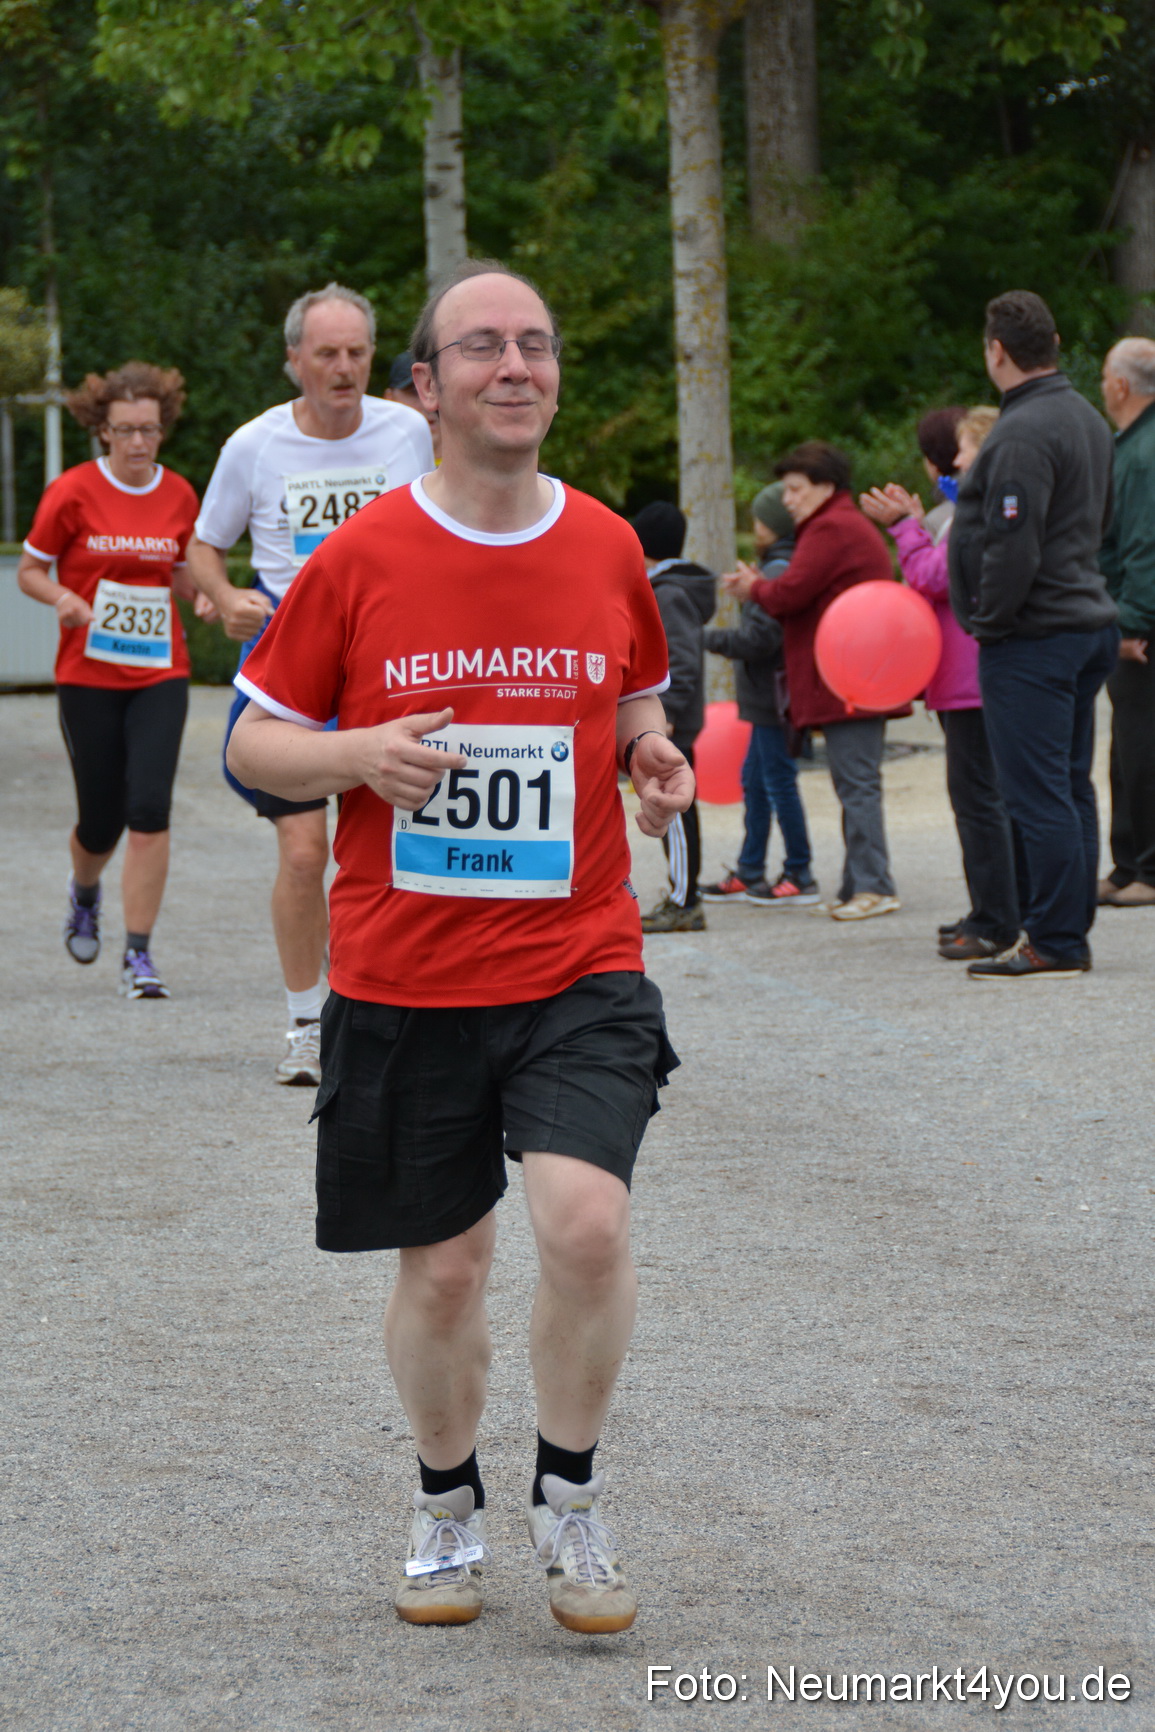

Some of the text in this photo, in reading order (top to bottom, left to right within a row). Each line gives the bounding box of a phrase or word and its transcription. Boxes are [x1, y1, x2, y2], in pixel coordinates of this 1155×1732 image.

[288, 476, 372, 491] PARTL Neumarkt
[87, 535, 173, 553] NEUMARKT
[101, 602, 167, 636] 2332
[385, 647, 578, 690] NEUMARKT
[496, 687, 577, 700] STARKE STADT
[459, 742, 544, 759] Neumarkt
[446, 846, 514, 873] Frank
